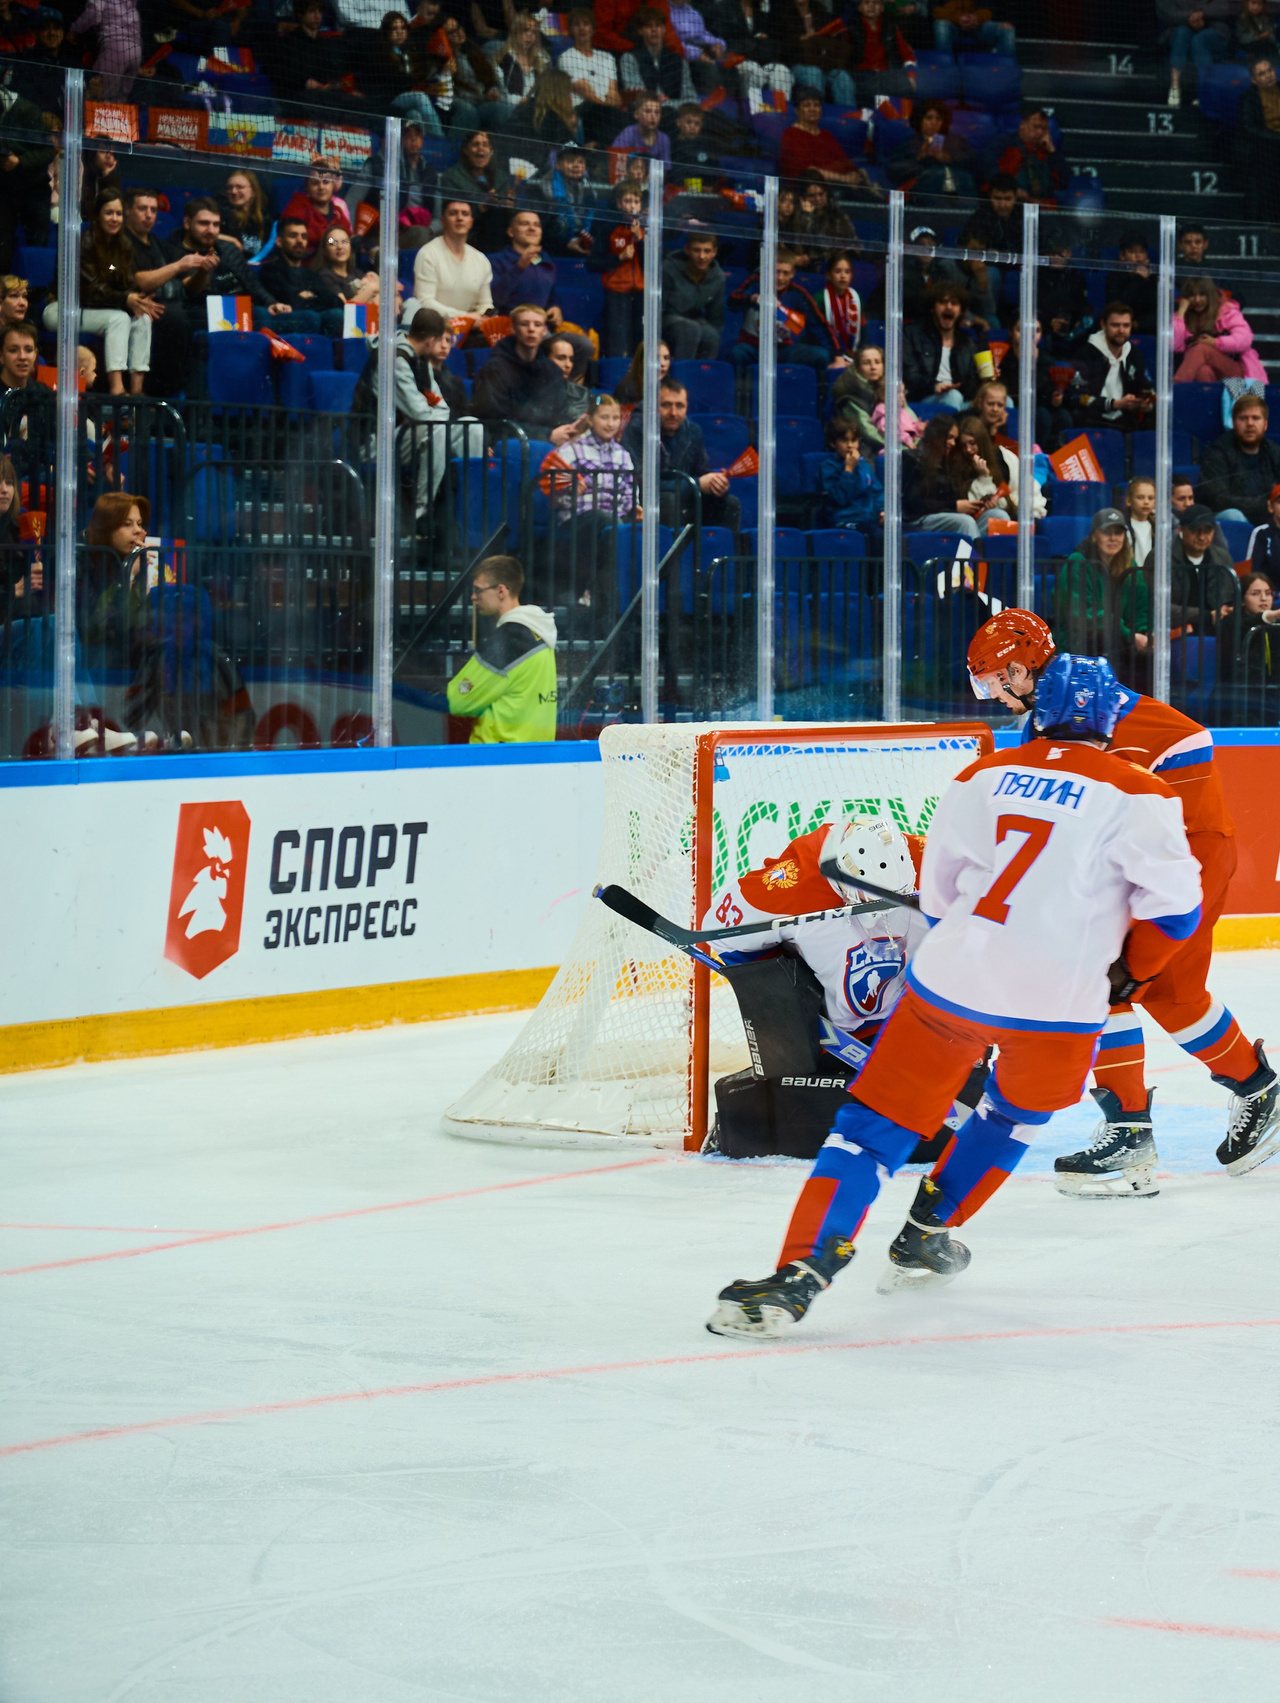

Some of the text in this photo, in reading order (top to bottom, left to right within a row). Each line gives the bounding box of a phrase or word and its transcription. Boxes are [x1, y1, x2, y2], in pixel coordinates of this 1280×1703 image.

[1108, 54, 1134, 75] 14
[1147, 112, 1174, 135] 13
[1191, 171, 1219, 194] 12
[1237, 235, 1259, 257] 11
[996, 643, 1016, 658] CCM
[269, 821, 428, 895] СПОРТ
[971, 813, 1056, 926] 7
[263, 898, 418, 950] ЭКСПРЕСС
[744, 1017, 765, 1077] BAUER
[781, 1076, 846, 1089] BAUER
